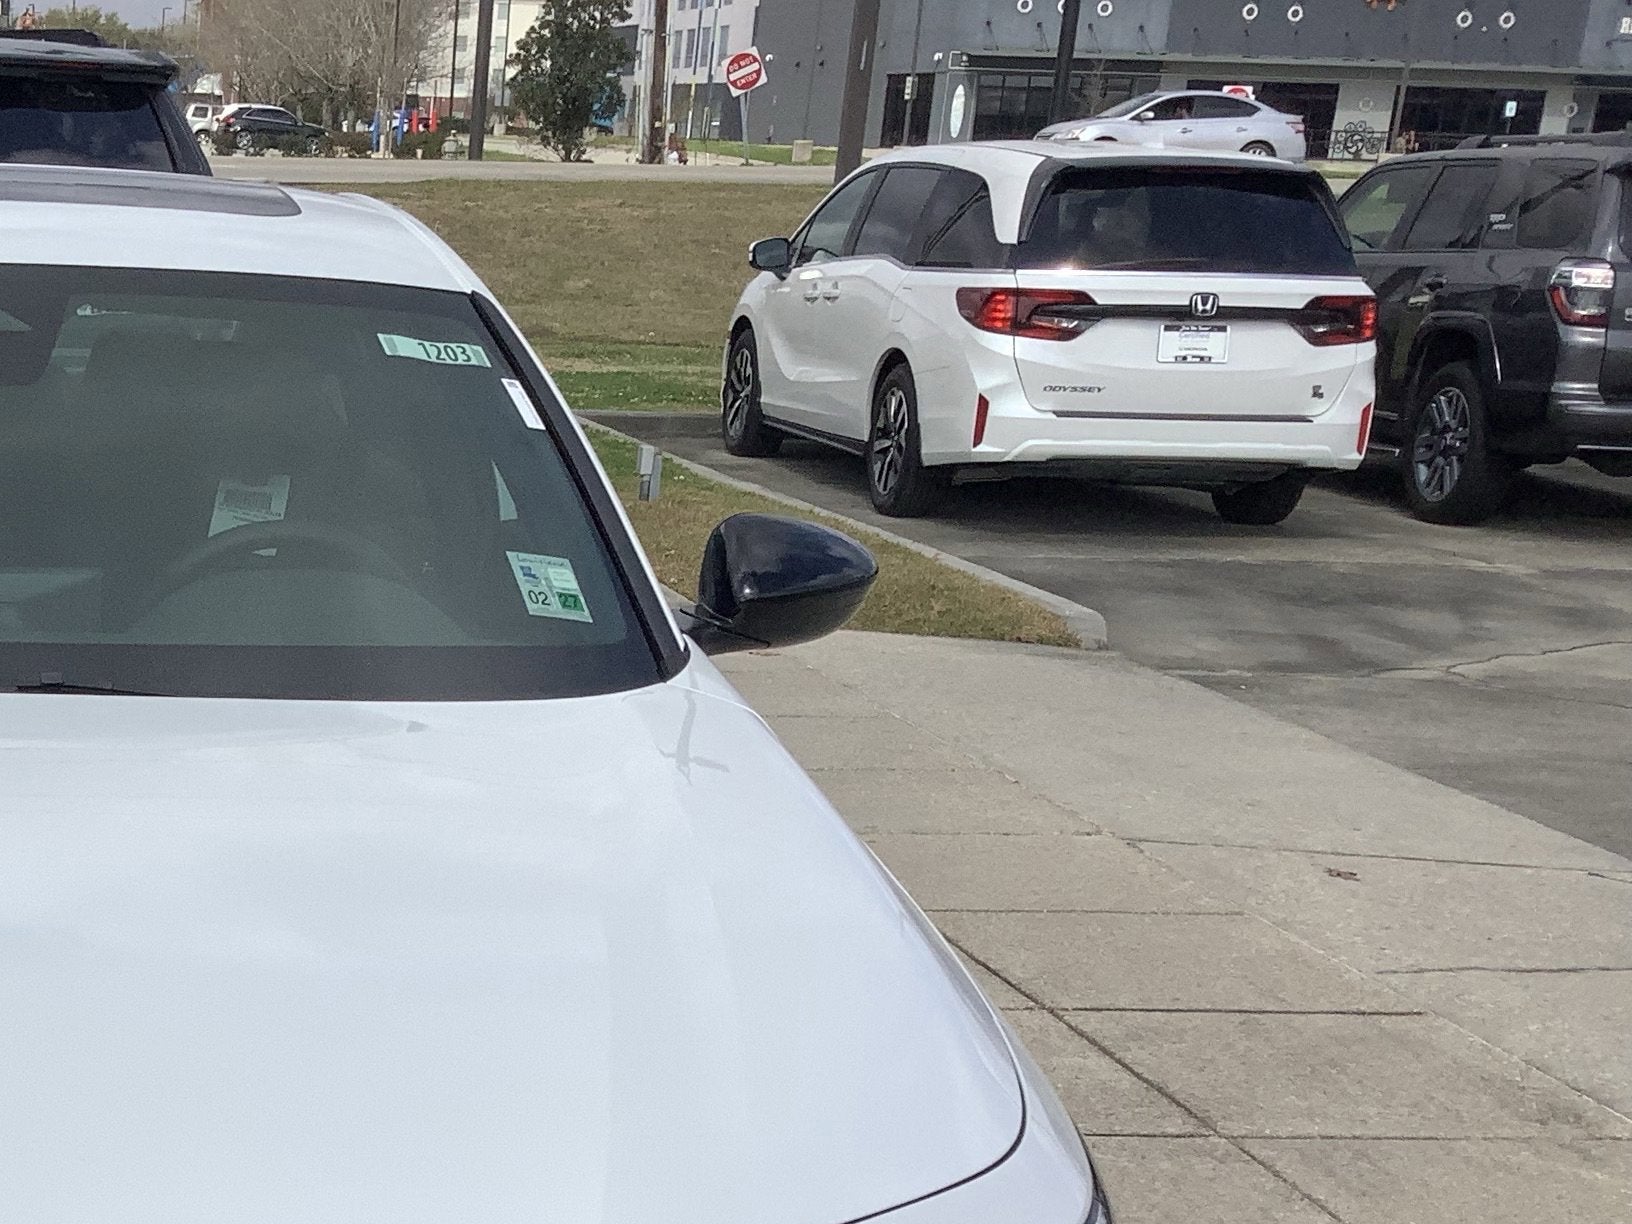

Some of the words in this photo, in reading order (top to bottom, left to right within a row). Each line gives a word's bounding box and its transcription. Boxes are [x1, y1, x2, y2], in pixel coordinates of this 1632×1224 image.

[729, 62, 739, 73] DO
[740, 56, 755, 67] NOT
[736, 72, 758, 87] ENTER
[418, 342, 472, 362] 1203
[1043, 385, 1106, 393] ODYSSEY
[528, 590, 551, 606] 02
